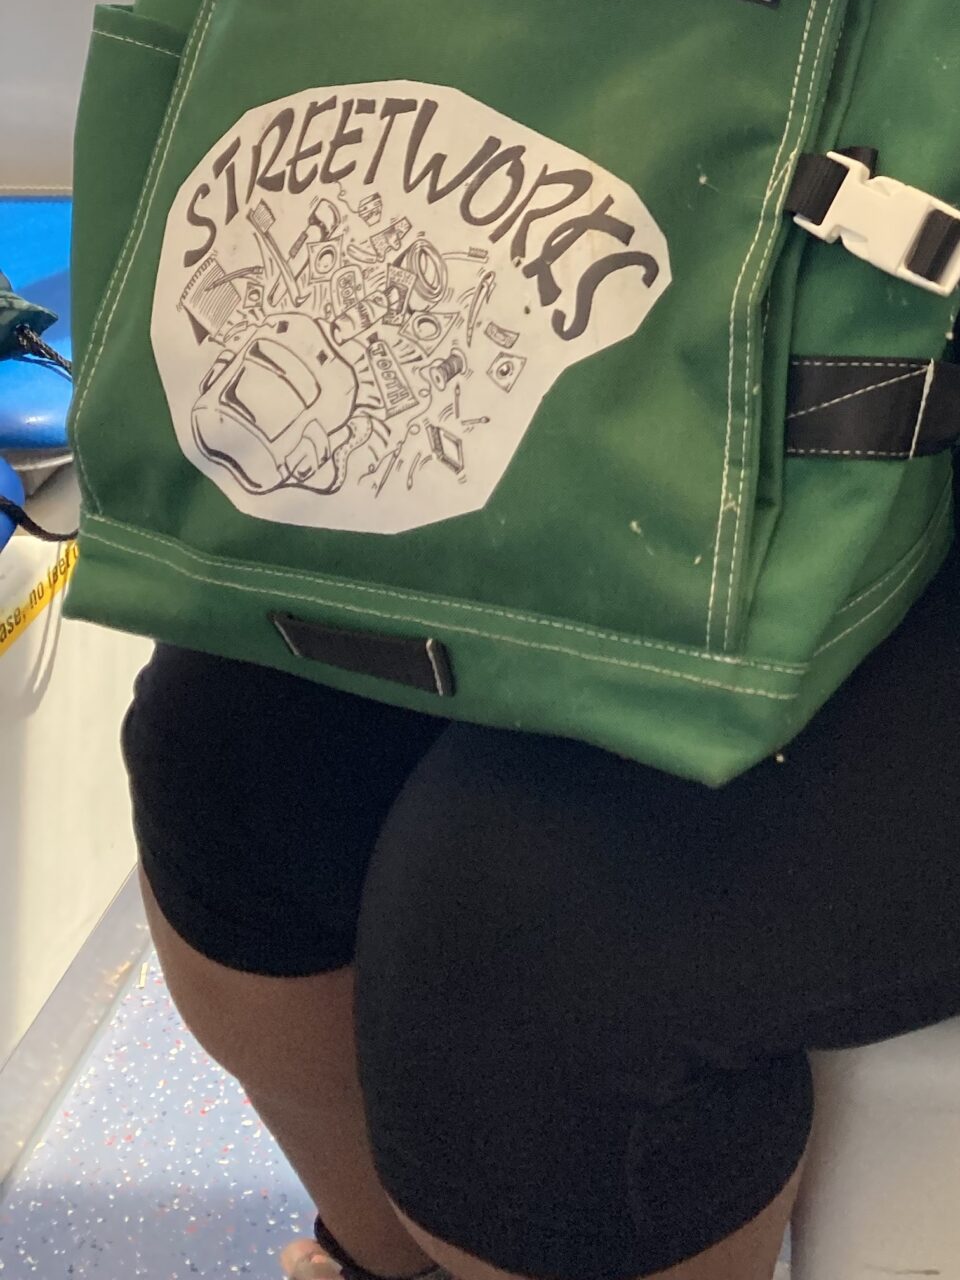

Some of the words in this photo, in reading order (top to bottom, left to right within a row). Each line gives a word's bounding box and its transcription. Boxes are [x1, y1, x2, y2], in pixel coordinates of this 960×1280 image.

[184, 95, 660, 341] STREETWORKS
[370, 341, 410, 405] TOOTH
[0, 607, 27, 643] ase,
[29, 581, 45, 609] no
